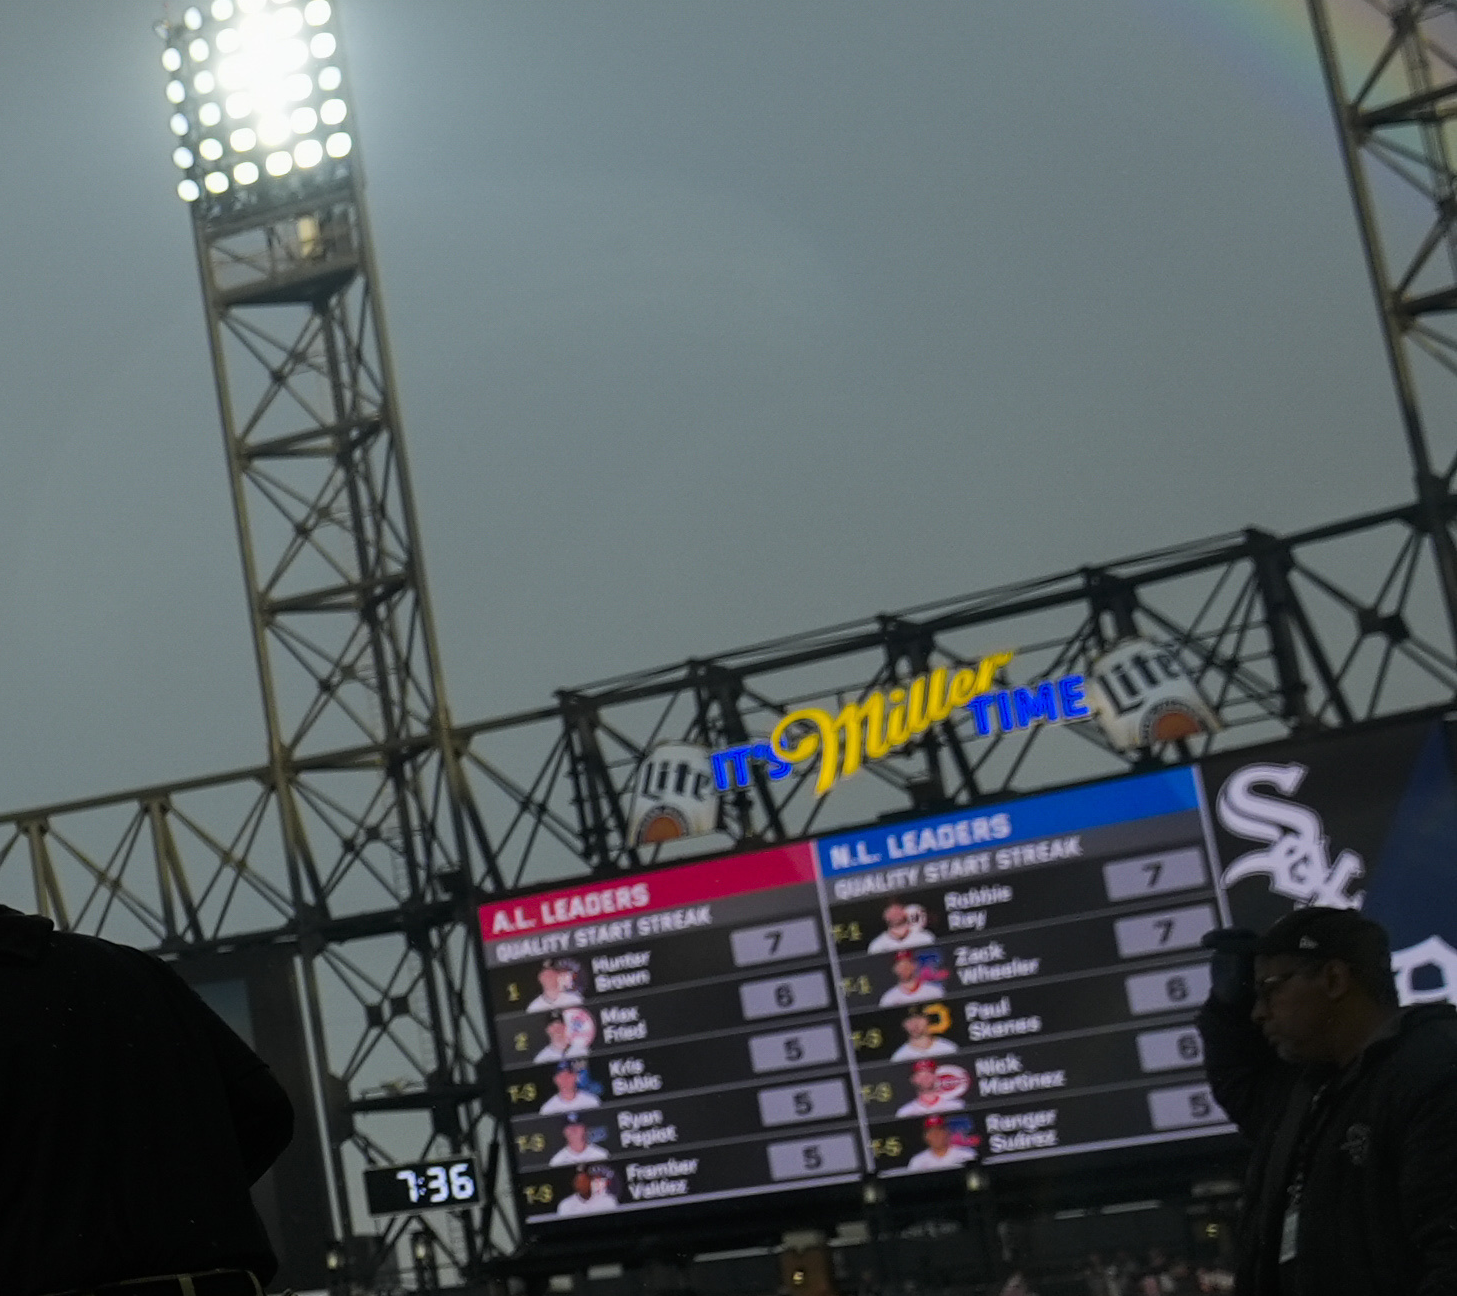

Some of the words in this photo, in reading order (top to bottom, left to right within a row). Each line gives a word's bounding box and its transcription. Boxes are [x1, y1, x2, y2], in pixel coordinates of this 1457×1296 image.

[710, 736, 793, 790] IT'S
[771, 653, 1014, 795] Miller
[966, 674, 1090, 737] TIME
[830, 842, 881, 870] N.L.
[887, 813, 1012, 859] LEADERS
[834, 867, 918, 900] QUALITY
[925, 853, 990, 883] START
[996, 835, 1083, 870] STREAK
[1141, 861, 1163, 888] 7
[492, 909, 536, 935] A.L.
[541, 882, 650, 924] LEADERS
[495, 932, 570, 961] QUALITY
[574, 922, 635, 950] START
[638, 905, 712, 936] STREAK
[1153, 918, 1175, 944] 7
[763, 931, 783, 956] 7
[396, 1162, 478, 1203] 7:36
